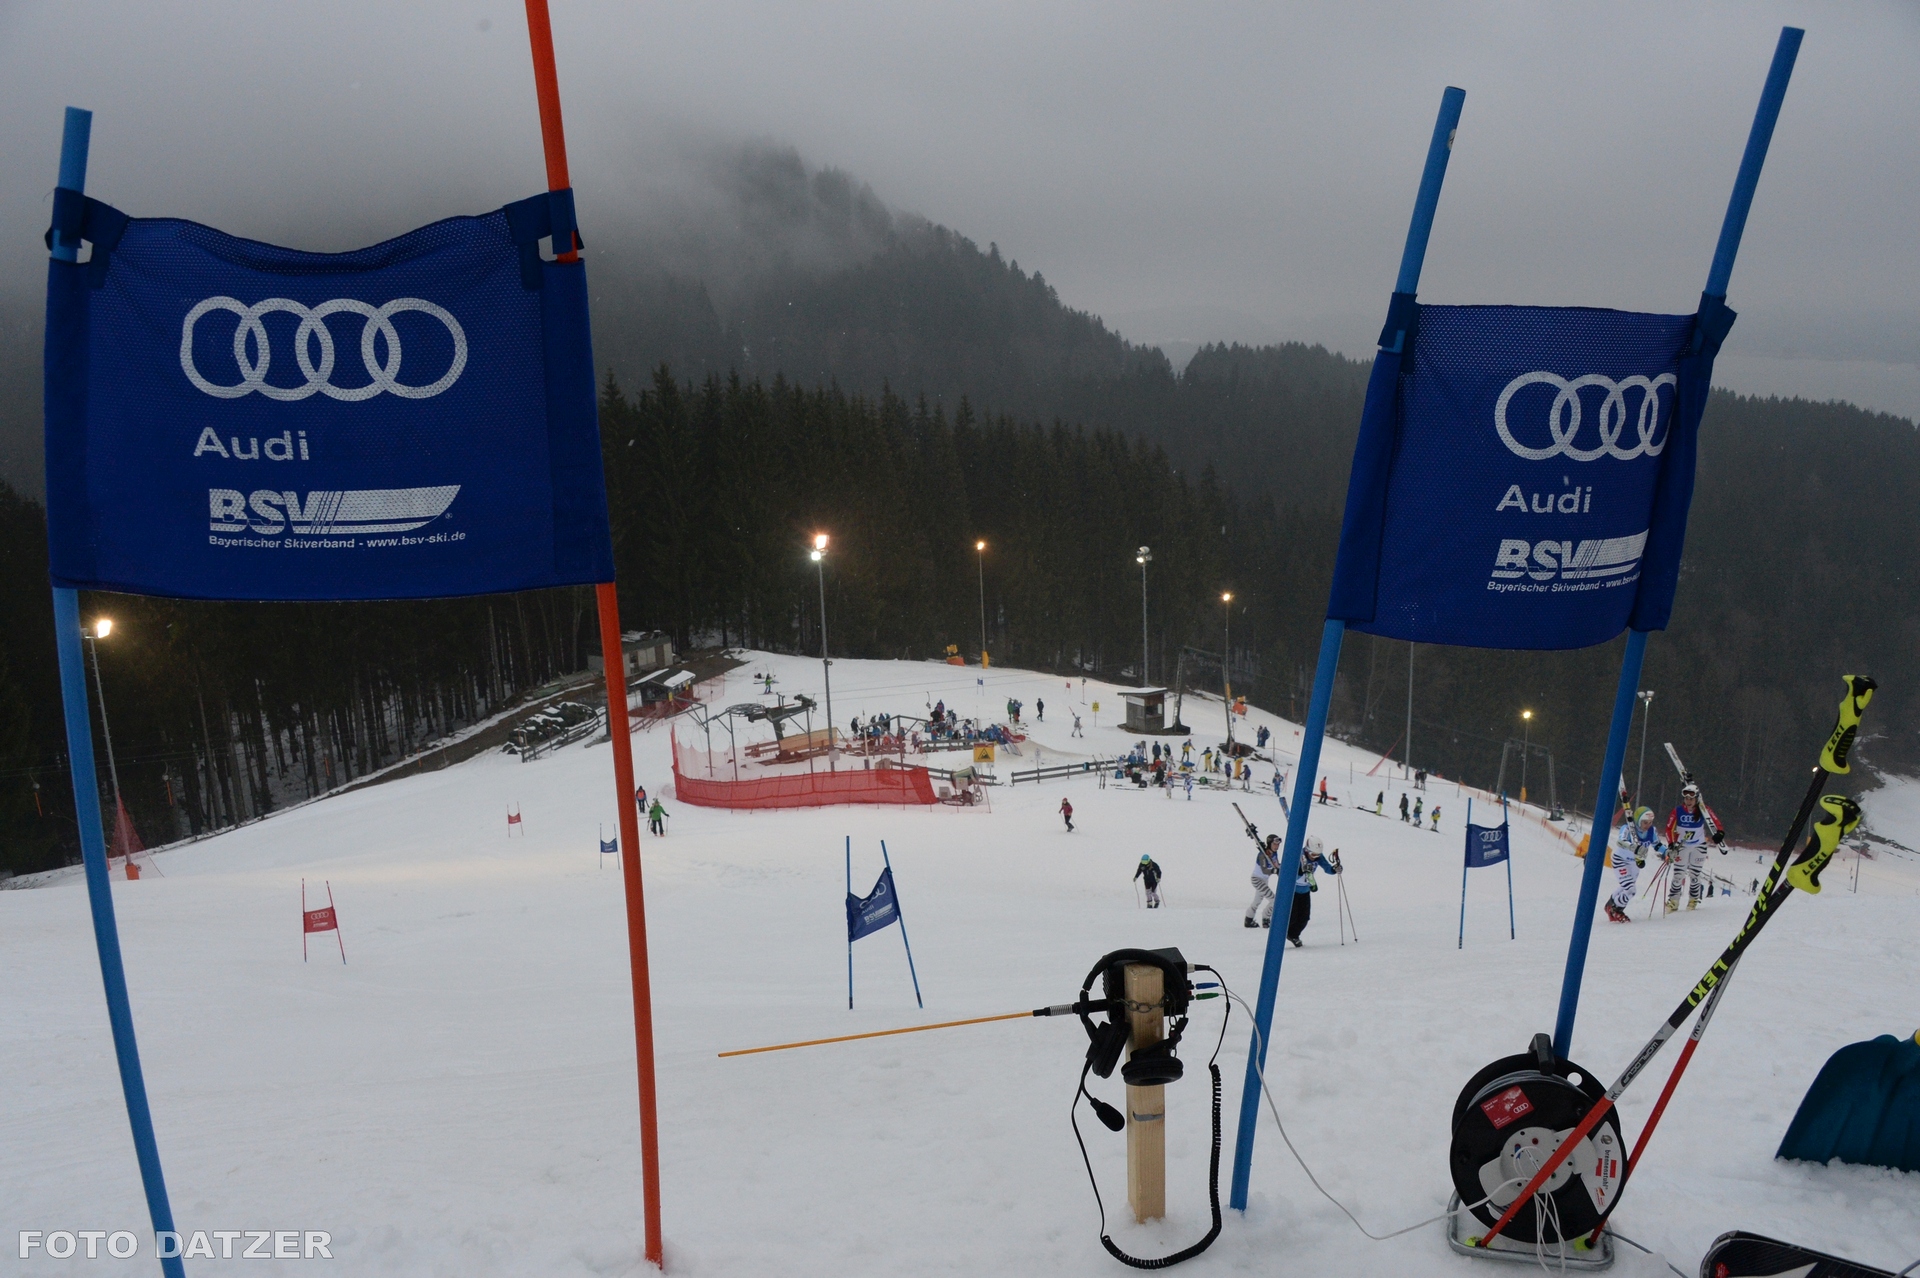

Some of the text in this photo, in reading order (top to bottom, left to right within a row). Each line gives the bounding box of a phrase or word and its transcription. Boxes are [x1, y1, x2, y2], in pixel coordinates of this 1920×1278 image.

[193, 426, 310, 461] Audi
[209, 488, 328, 535] BSV
[1495, 484, 1593, 514] Audi
[209, 535, 282, 549] Bayerischer
[284, 537, 355, 549] Skiverband
[366, 531, 466, 548] www.bsv-ski.de
[1491, 539, 1591, 581] BSV
[1487, 581, 1549, 593] Bayerischer
[1551, 582, 1600, 593] Skiverband
[1827, 724, 1845, 753] LEKI
[1825, 797, 1855, 810] LEKI
[1802, 852, 1827, 876] LEKI
[1688, 957, 1729, 1008] LEKI
[1622, 1041, 1659, 1084] WORLDCUP
[1603, 1149, 1611, 1188] brennenstuhl
